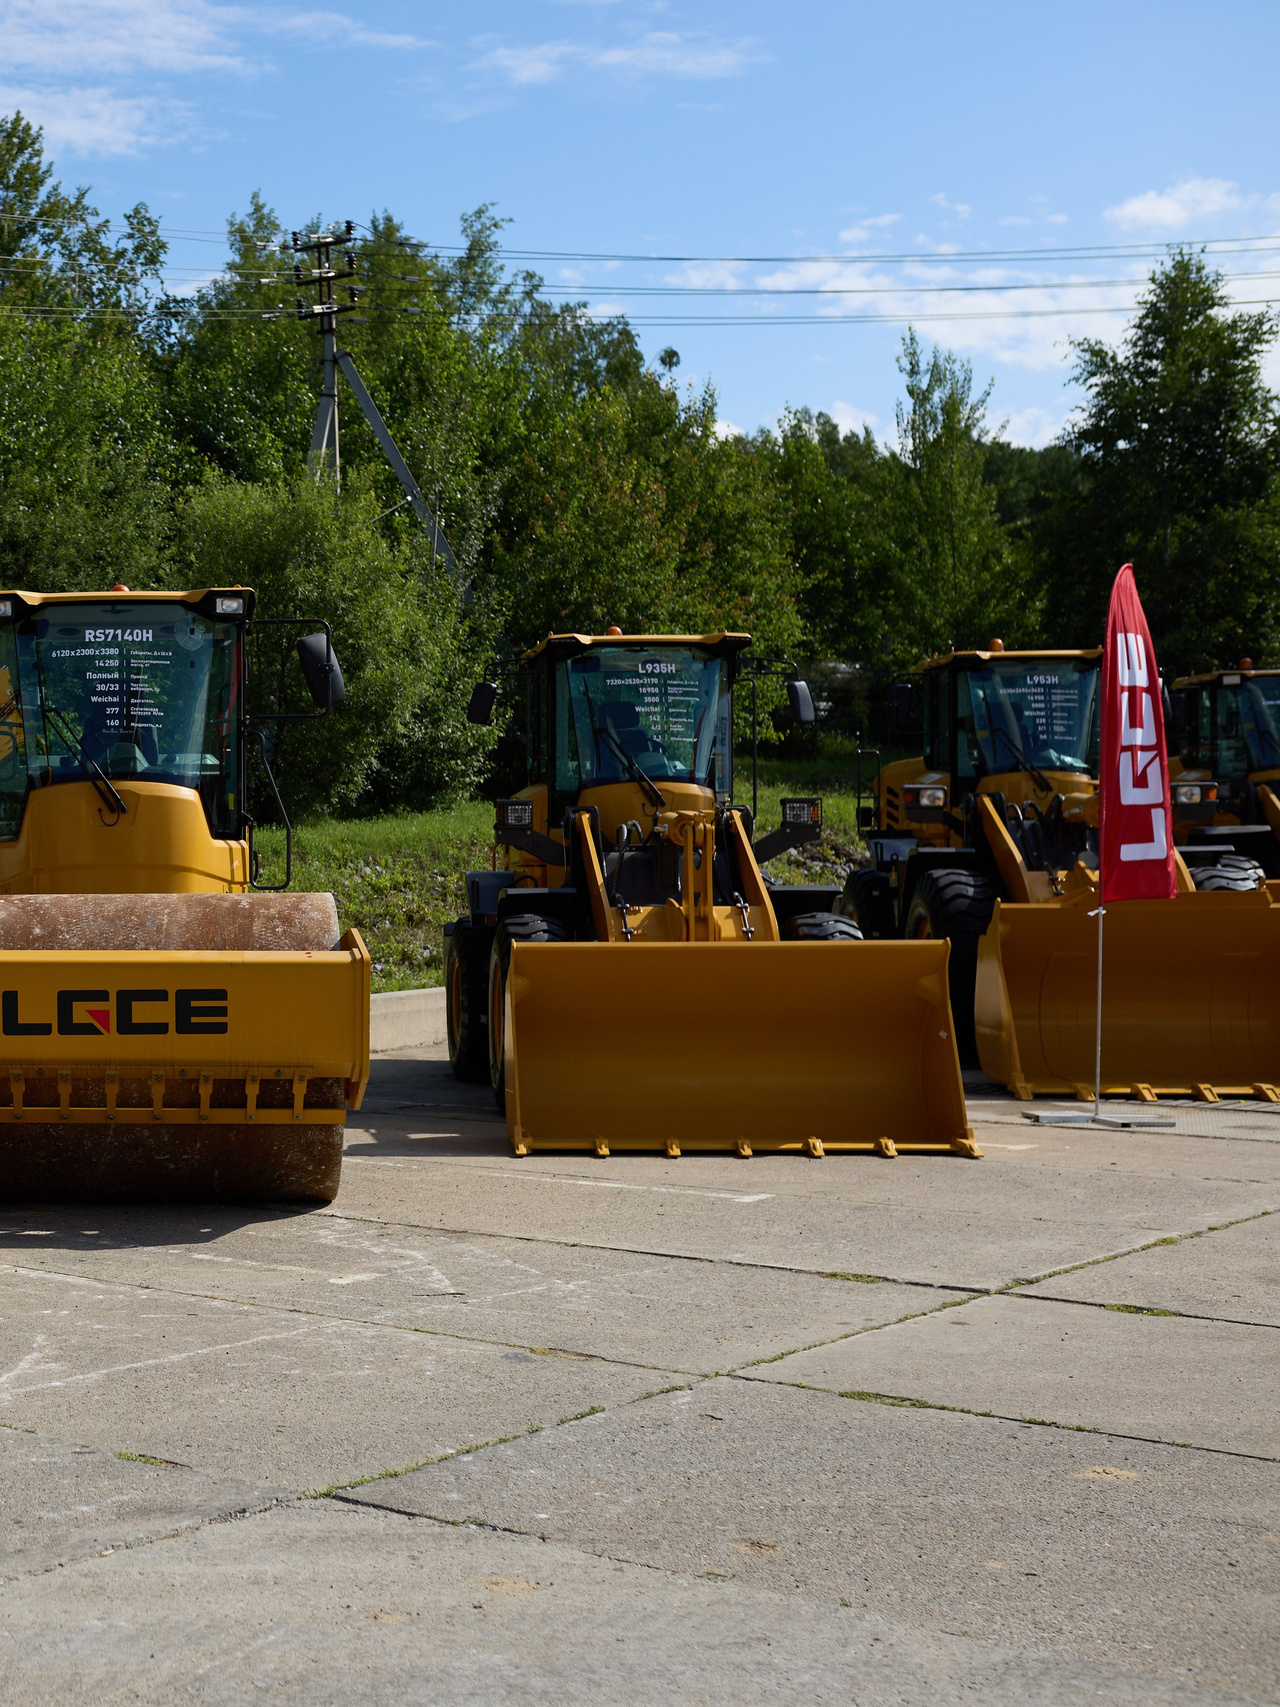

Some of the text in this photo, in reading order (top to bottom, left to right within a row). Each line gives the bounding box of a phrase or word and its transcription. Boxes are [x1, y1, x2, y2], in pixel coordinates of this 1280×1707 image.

[85, 629, 153, 642] RS7140H
[638, 663, 676, 674] L935H
[86, 671, 119, 679] Полный
[1026, 675, 1059, 685] L953H
[95, 683, 119, 691] 30/33
[90, 695, 119, 703] Weichai
[1117, 632, 1167, 862] LGCE
[1, 988, 228, 1036] LGCE
